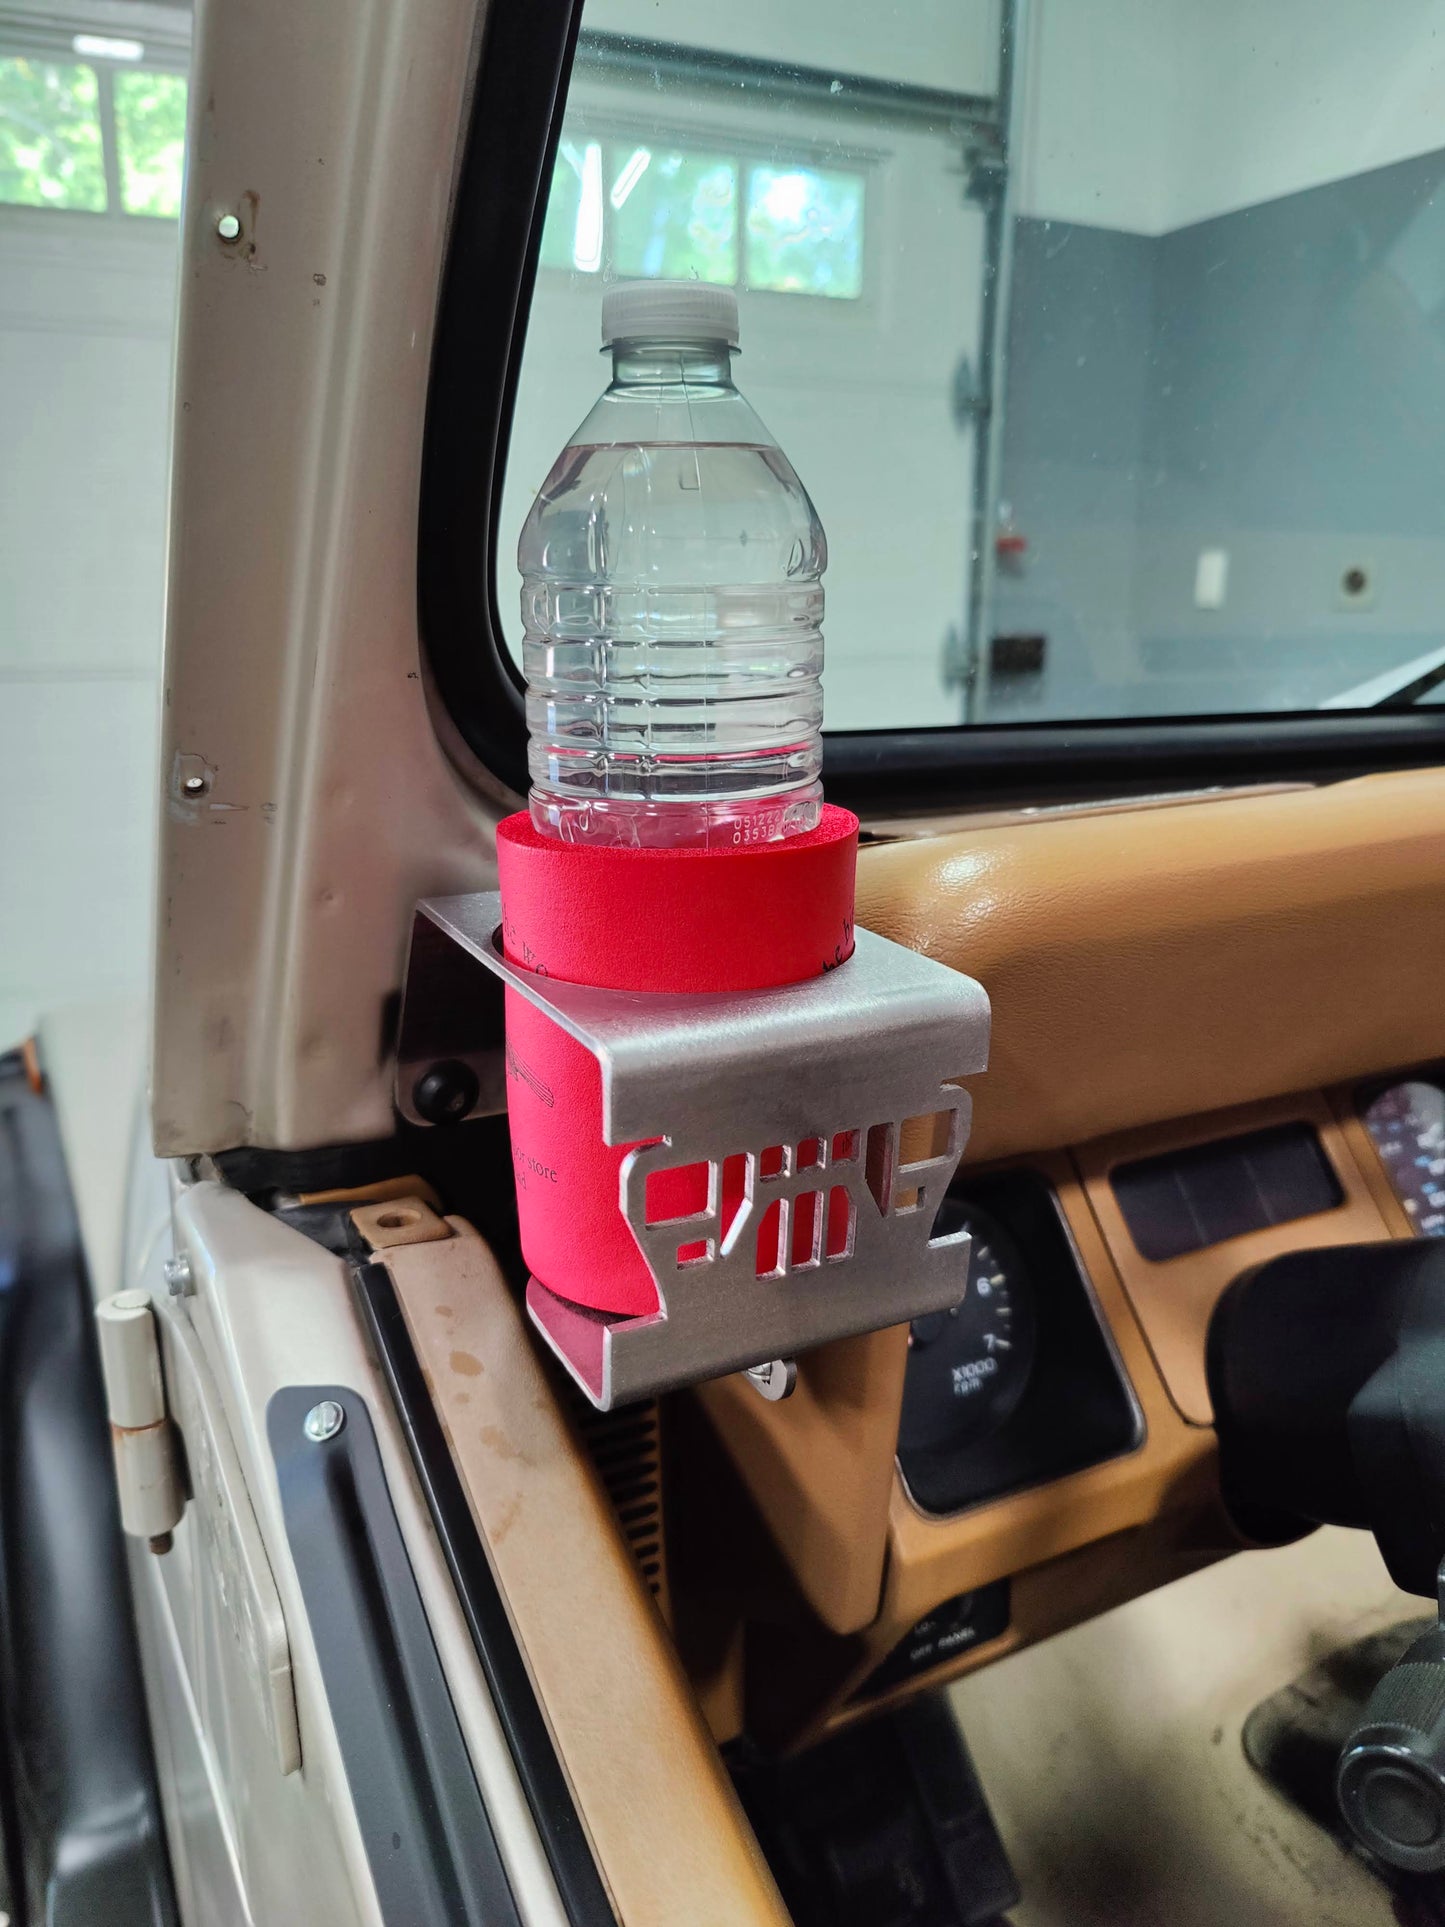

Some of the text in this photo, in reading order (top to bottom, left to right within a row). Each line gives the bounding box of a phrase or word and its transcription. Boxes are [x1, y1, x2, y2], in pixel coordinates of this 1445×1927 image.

[734, 810, 780, 830] 051222
[527, 1157, 558, 1183] store
[977, 1277, 991, 1297] 6
[983, 1333, 997, 1350] 7
